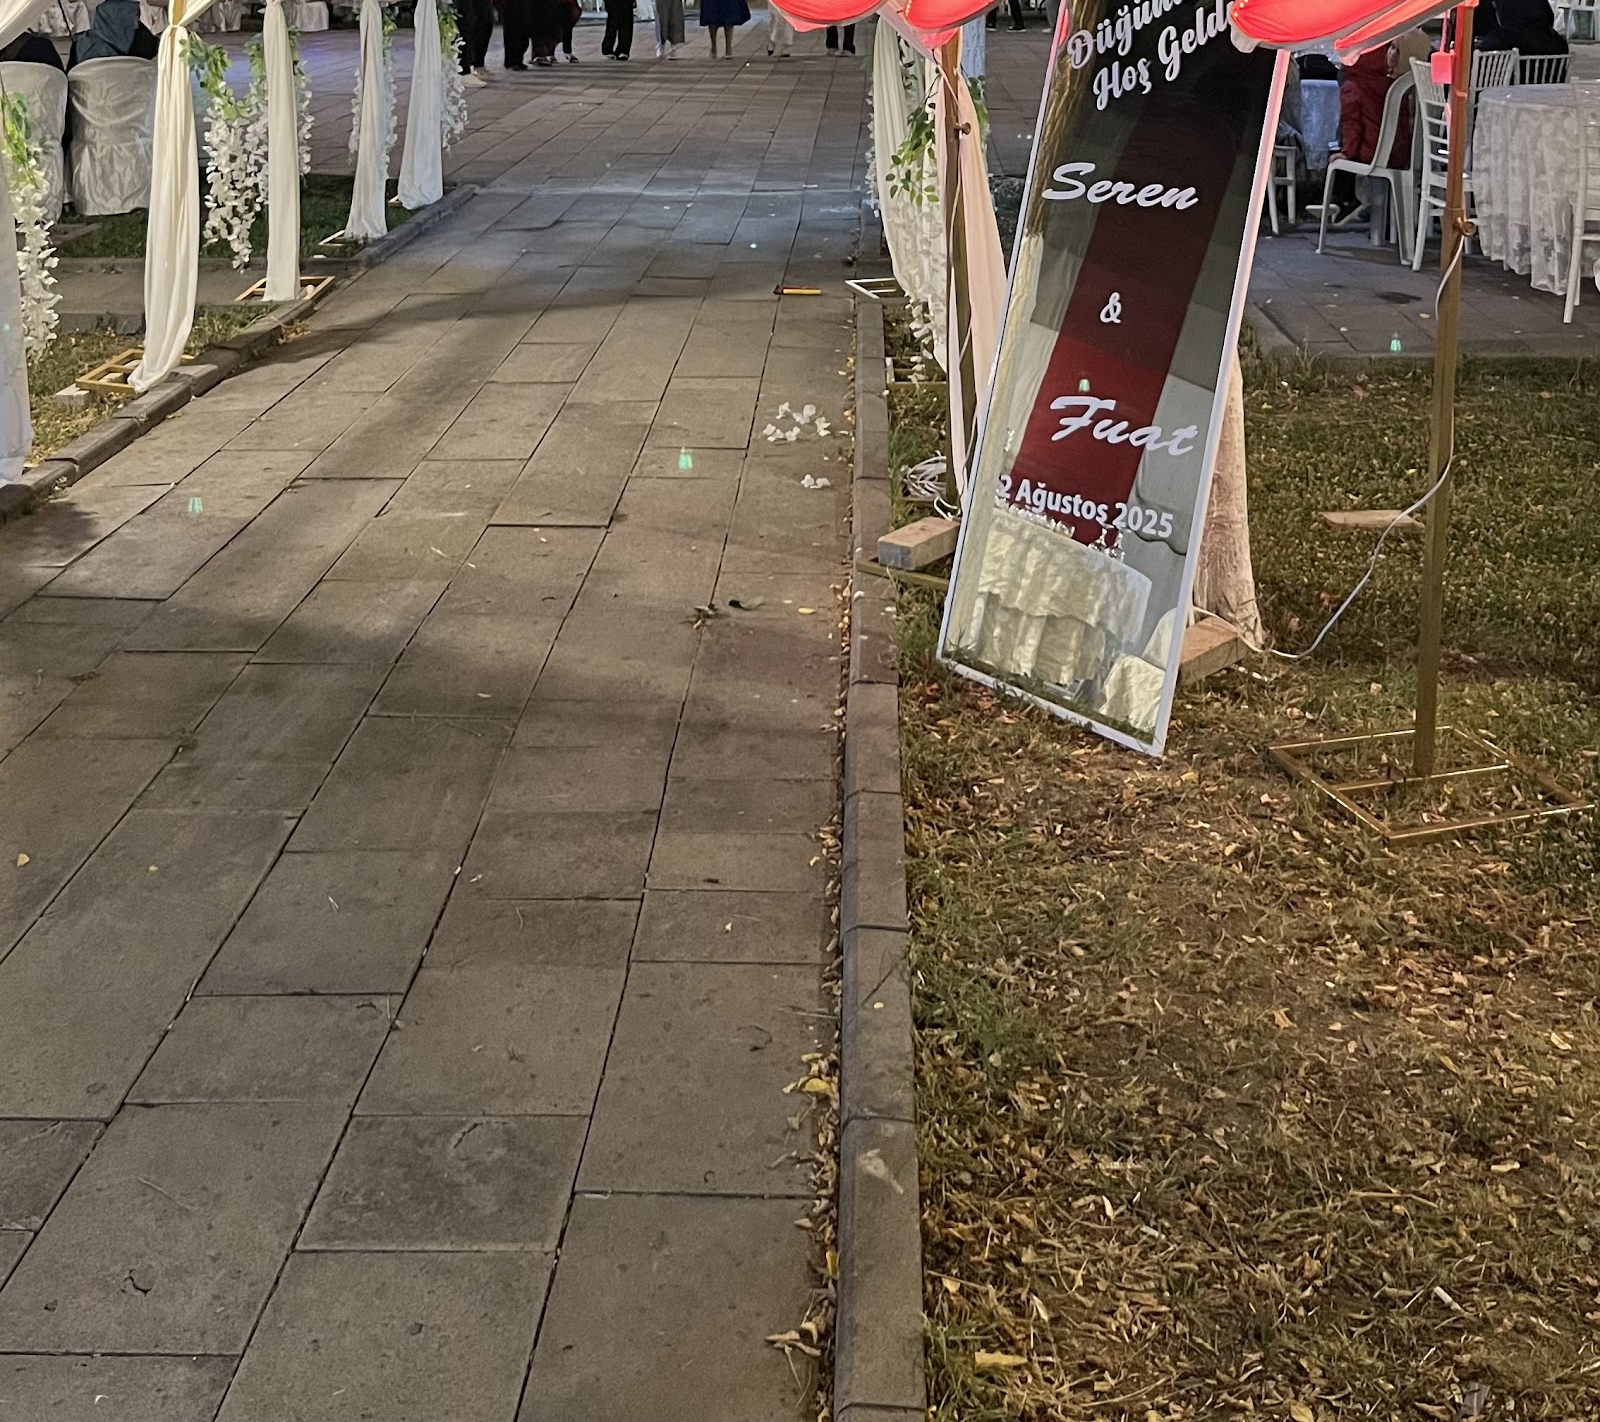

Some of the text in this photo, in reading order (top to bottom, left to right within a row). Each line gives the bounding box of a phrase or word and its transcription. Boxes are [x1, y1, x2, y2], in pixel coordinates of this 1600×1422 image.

[1092, 57, 1152, 111] Hoş
[1041, 162, 1199, 210] Seren
[1099, 291, 1122, 323] &
[1049, 395, 1198, 456] Fuat
[1014, 478, 1109, 524] Ağustos
[1112, 502, 1174, 538] 2025
